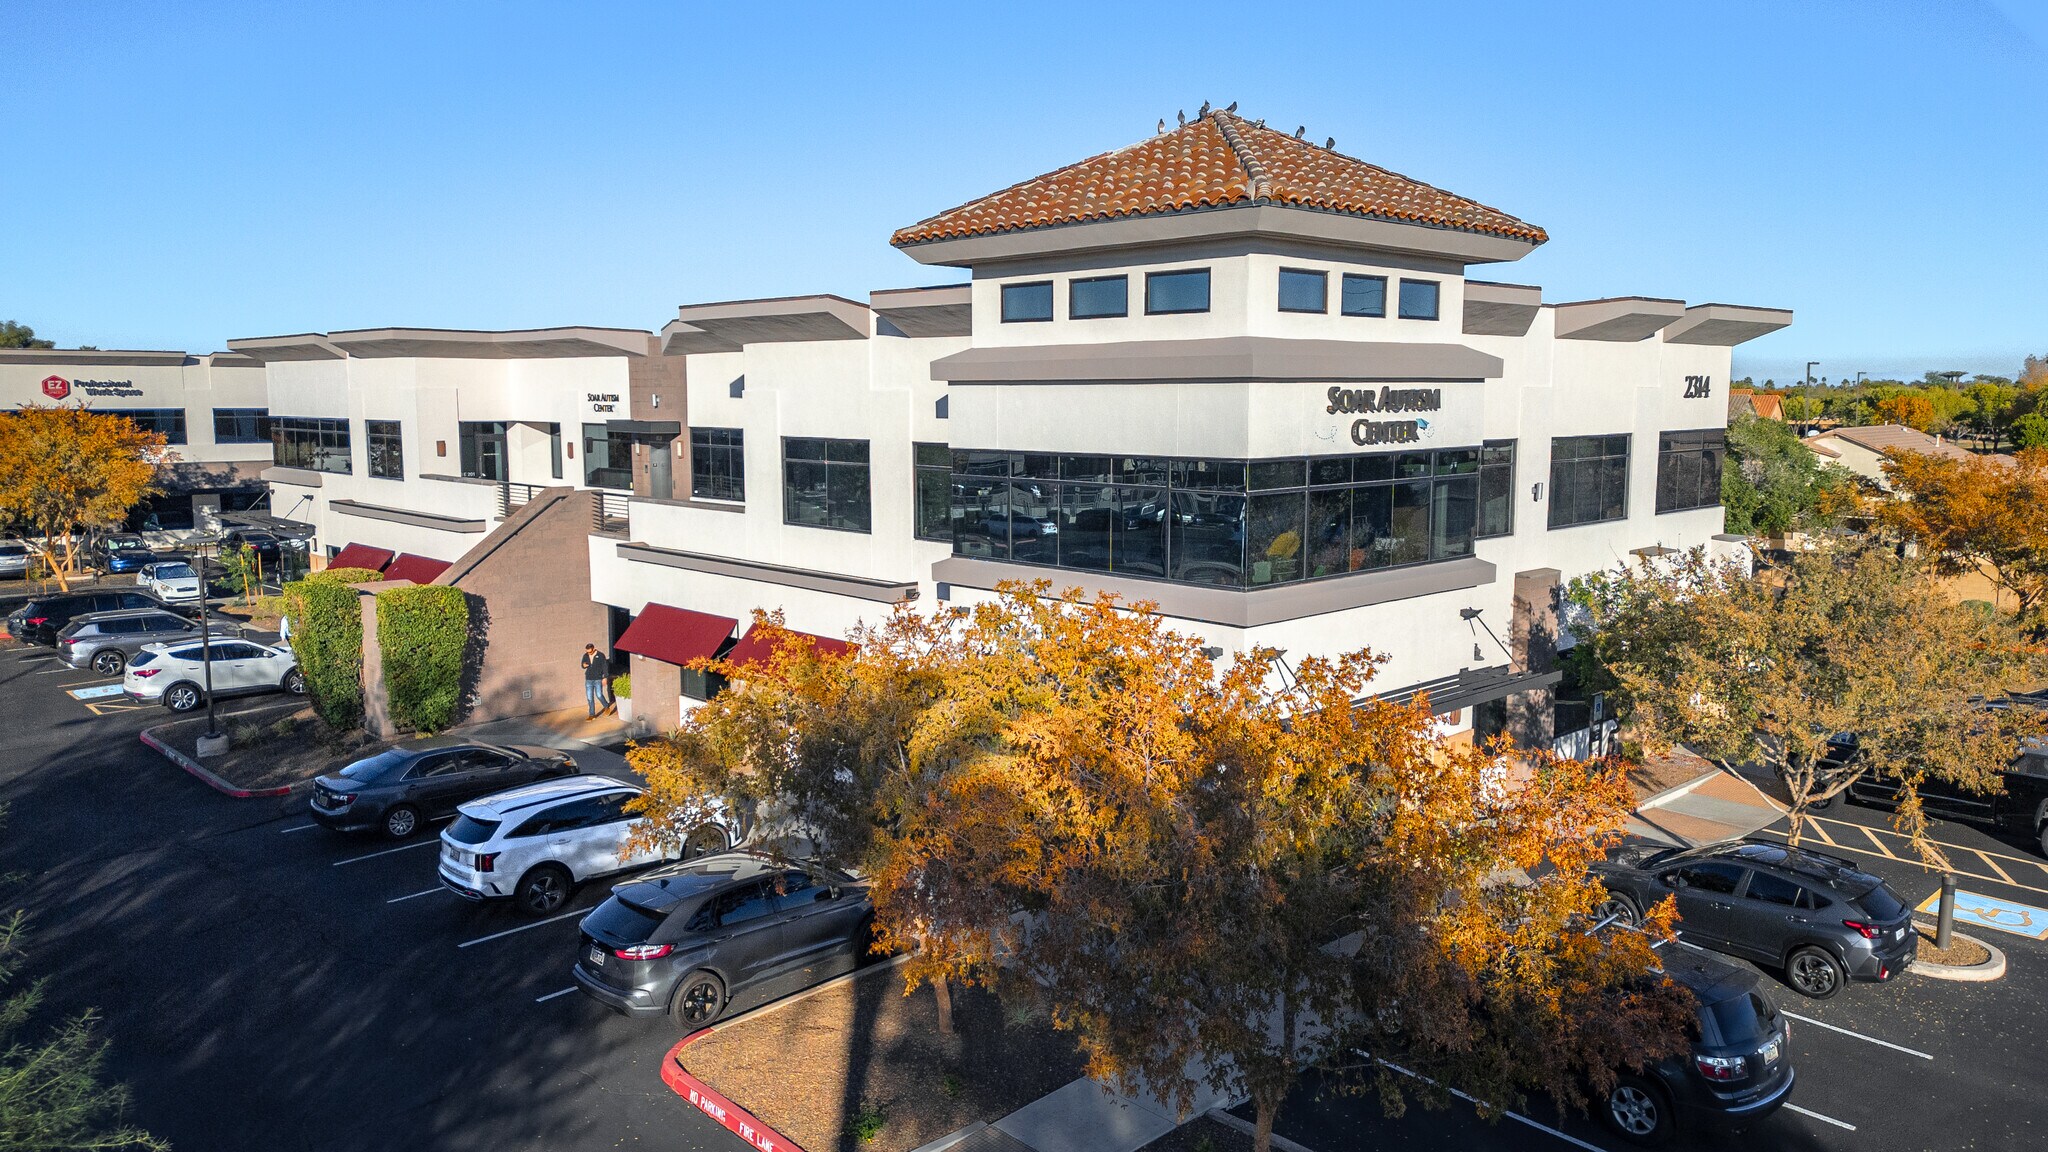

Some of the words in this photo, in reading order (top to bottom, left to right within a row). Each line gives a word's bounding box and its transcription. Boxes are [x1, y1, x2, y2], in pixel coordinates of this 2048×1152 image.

[47, 380, 62, 390] EZ
[73, 379, 132, 388] Professional
[1683, 375, 1711, 399] 2314
[587, 392, 600, 402] SOAR
[600, 392, 619, 402] AUTISM
[593, 403, 614, 412] CENTER
[1326, 386, 1375, 415] SOAR
[1377, 386, 1441, 413] AUTISM
[1351, 419, 1420, 446] CENTER
[690, 1089, 698, 1105] NO
[700, 1097, 726, 1122] PARKING
[739, 1122, 754, 1142] FIRE
[757, 1133, 774, 1152] LANE
